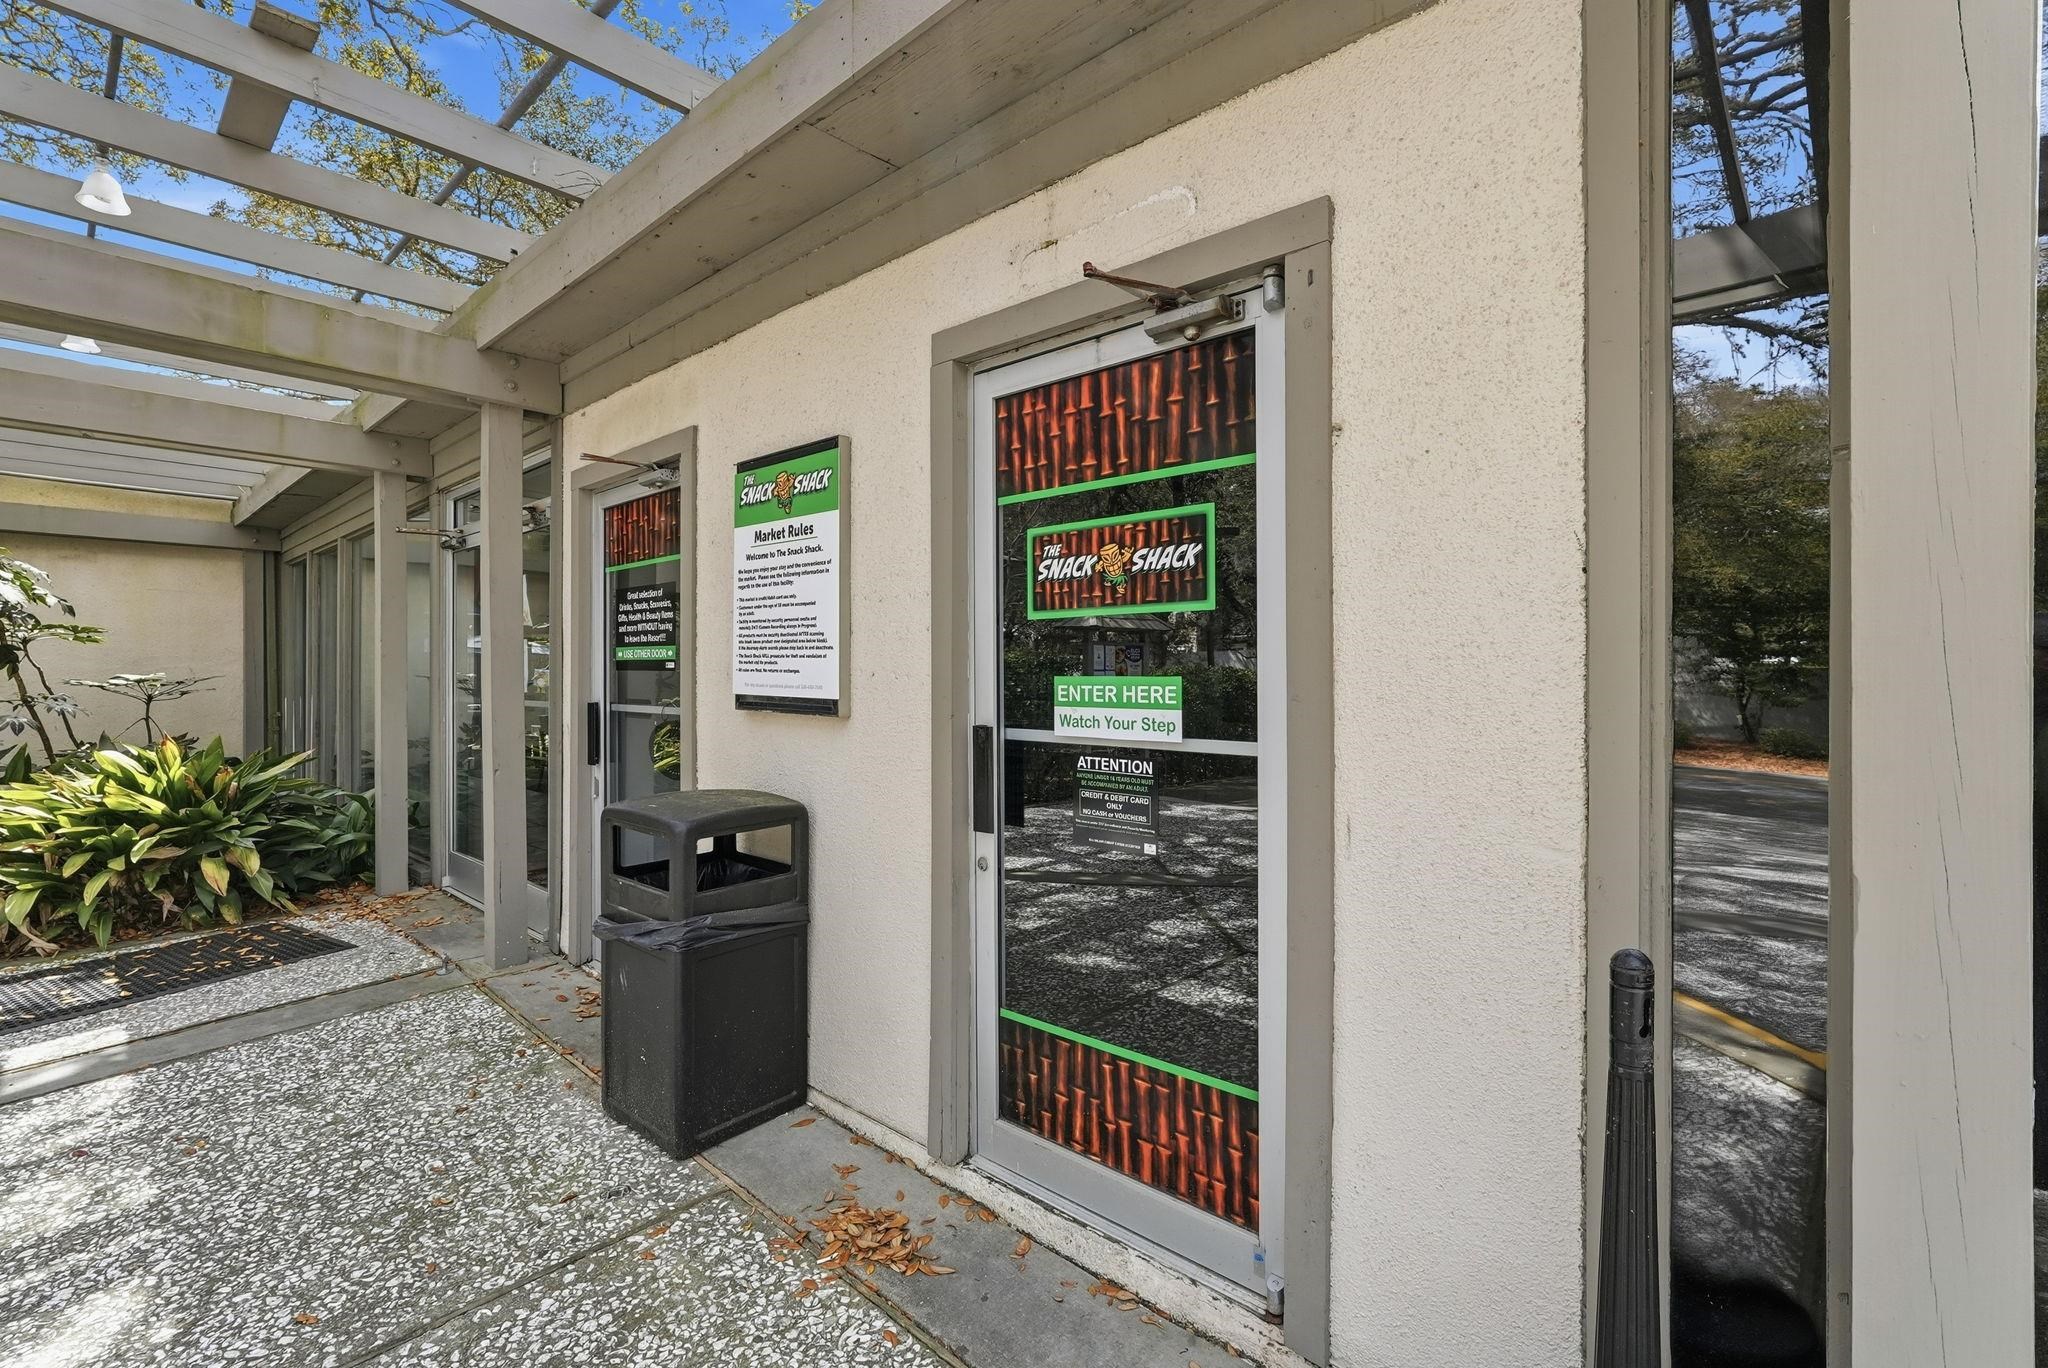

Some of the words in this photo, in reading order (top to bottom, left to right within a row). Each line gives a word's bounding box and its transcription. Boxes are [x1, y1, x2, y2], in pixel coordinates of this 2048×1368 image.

[740, 482, 776, 507] SNACK
[793, 469, 833, 495] SHACK
[743, 474, 756, 487] THE
[754, 526, 786, 544] Market
[788, 523, 814, 538] Rules
[746, 553, 769, 561] Welcome
[776, 549, 786, 557] The
[787, 547, 804, 556] Snack
[804, 544, 824, 553] Shack.
[1042, 543, 1062, 559] THE
[1037, 554, 1098, 582] SNACK
[1131, 542, 1203, 573] SHACK
[627, 592, 639, 600] Great
[639, 590, 657, 598] selection
[658, 588, 663, 596] of
[628, 612, 641, 621] Health
[646, 611, 660, 621] Beauty
[637, 622, 657, 631] WITHOUT
[658, 621, 672, 631] having
[623, 649, 633, 658] USE
[634, 649, 650, 658] OTHER
[651, 649, 667, 657] DOOR
[1057, 685, 1117, 703] ENTER
[1122, 685, 1177, 704] HERE
[1059, 713, 1100, 729] Watch
[1104, 715, 1137, 730] Your
[1141, 716, 1176, 736] Step
[1077, 755, 1153, 775] ATTENTION
[1087, 780, 1118, 789] ACCOMPANIED
[1080, 790, 1103, 799] CREDIT
[1110, 794, 1129, 802] DEBIT
[1130, 797, 1149, 805] CARD
[1106, 802, 1123, 810] ONLY
[1092, 809, 1108, 817] CASH
[1114, 812, 1147, 822] VOUCHERS
